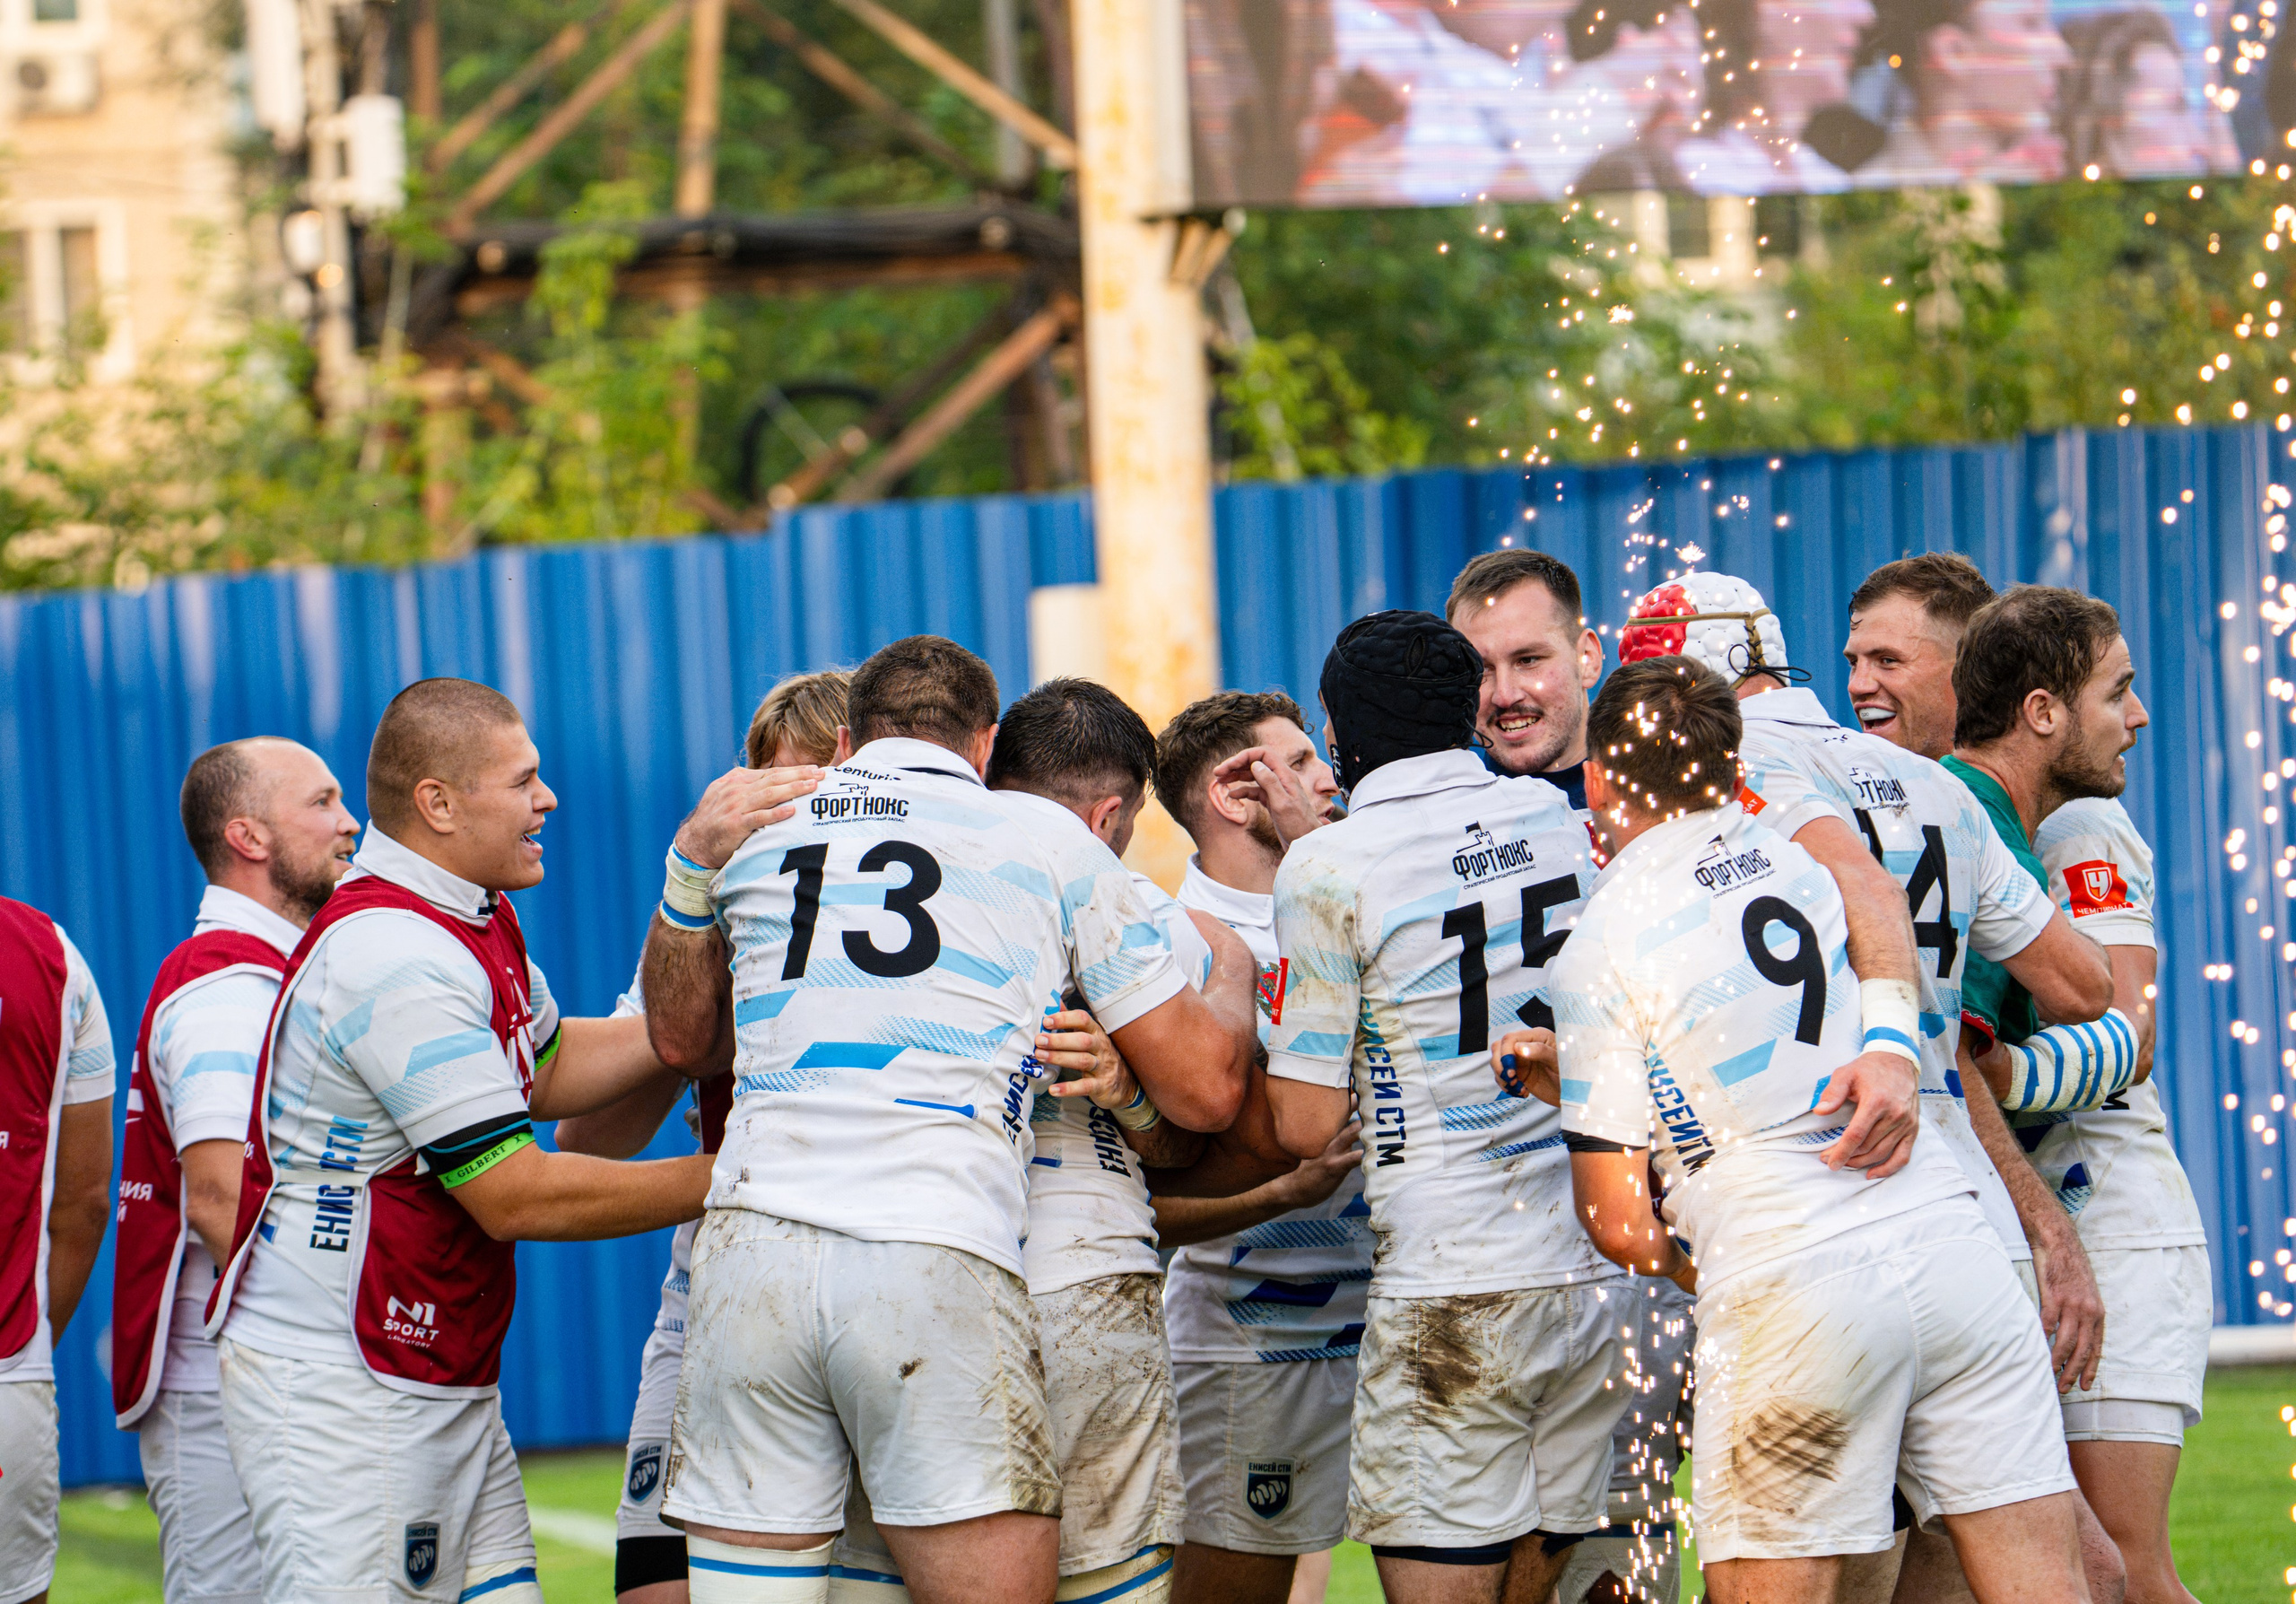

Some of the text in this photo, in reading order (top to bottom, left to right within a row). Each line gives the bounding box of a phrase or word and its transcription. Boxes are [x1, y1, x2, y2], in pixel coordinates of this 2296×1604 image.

[778, 839, 943, 981] 13
[1440, 872, 1581, 1057] 15
[1742, 895, 1827, 1047] 9
[457, 1144, 507, 1178] GILBERT
[1375, 1106, 1407, 1168] СТМ
[383, 1318, 439, 1341] SPORT
[1248, 1461, 1292, 1473] ЕНИСЕЙ СТМ
